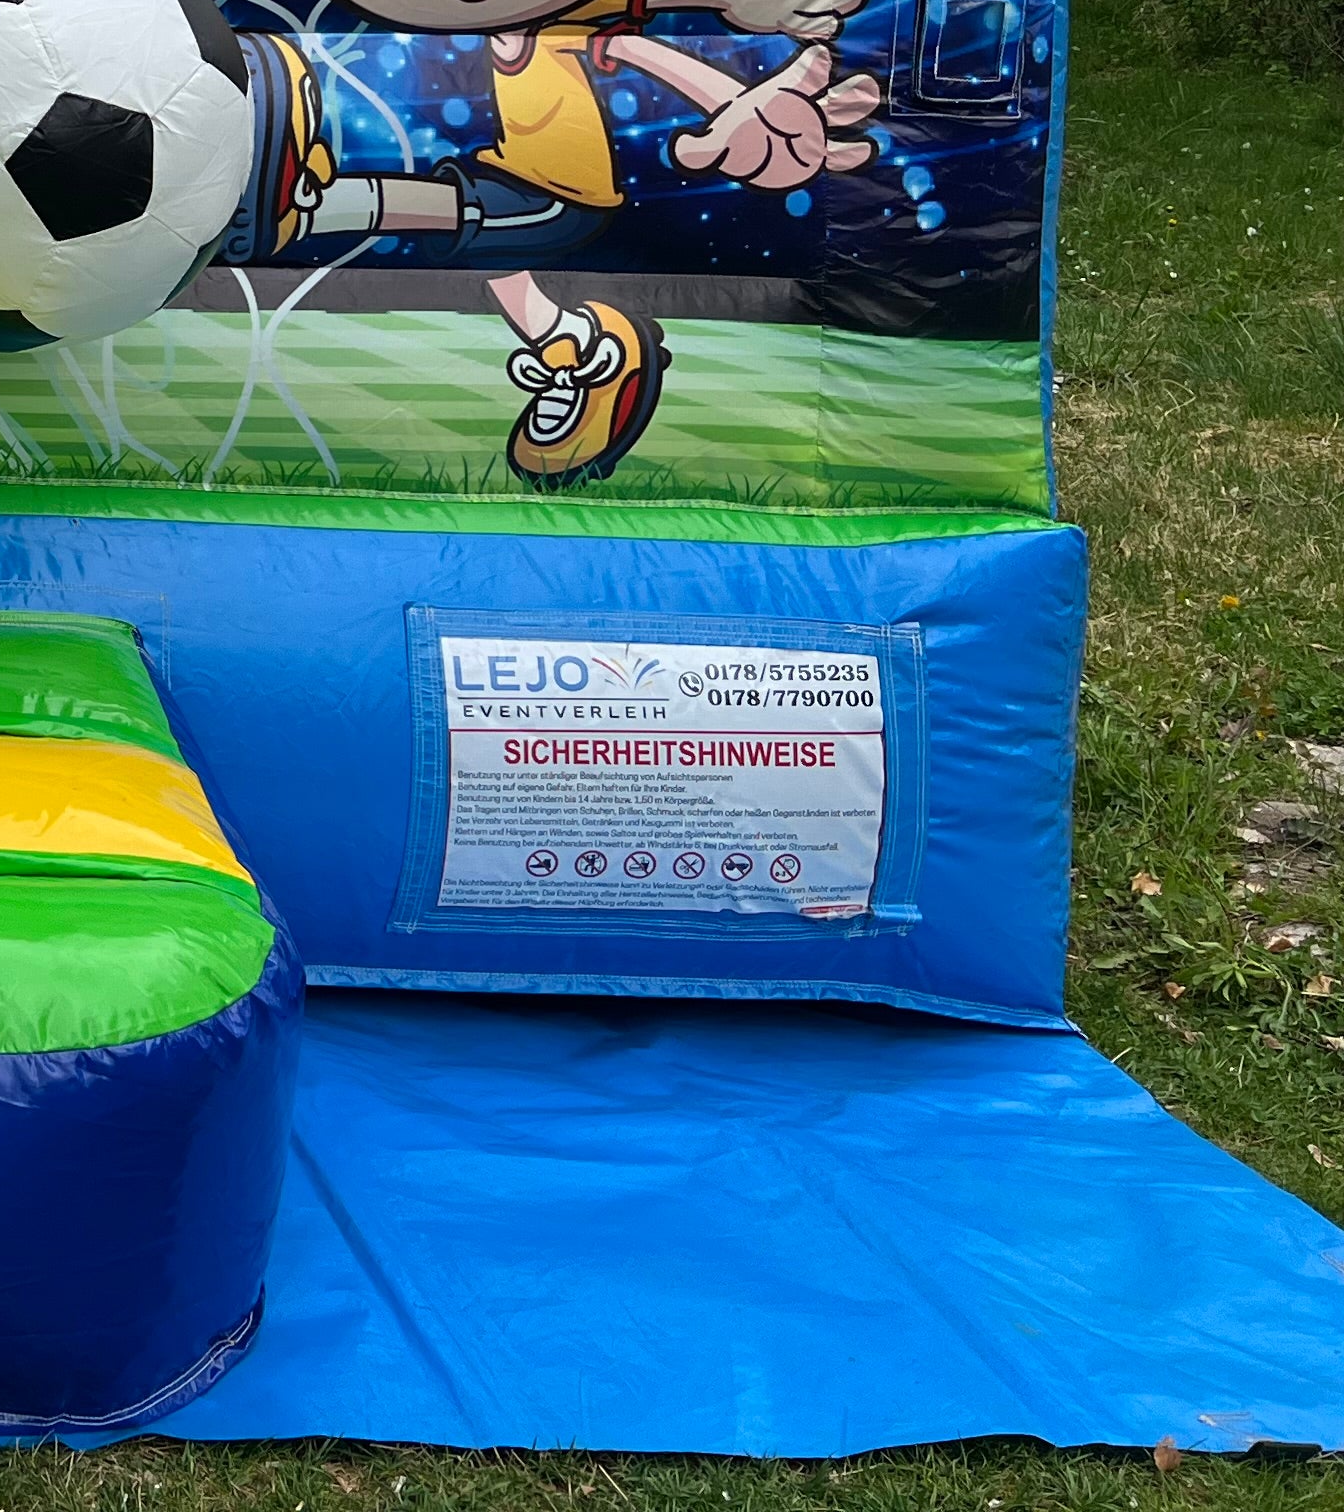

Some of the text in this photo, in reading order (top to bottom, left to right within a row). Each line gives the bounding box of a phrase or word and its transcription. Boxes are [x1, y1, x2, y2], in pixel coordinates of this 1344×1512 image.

[453, 656, 588, 692] LEJO
[705, 663, 869, 682] 0178/5755235
[708, 689, 874, 707] 0178/7790700
[464, 705, 666, 718] EVENTVERLEIH
[504, 740, 835, 766] SICHERHEITSHINWEISE
[458, 770, 501, 781] Benutzung
[657, 773, 733, 782] Aufsichtspersonen
[458, 782, 500, 792] Benutzung
[503, 783, 515, 791] auf
[518, 784, 544, 792] eigene
[458, 794, 500, 804] Benutzung
[533, 795, 562, 803] Kindern
[564, 795, 576, 803] bis
[591, 796, 613, 804] Jahre
[475, 806, 500, 815] Tragen
[519, 807, 562, 815] Mitbringen
[687, 808, 723, 816] scharfen
[831, 809, 840, 817] ist
[685, 819, 695, 827] ist
[638, 830, 653, 838] und
[478, 839, 520, 848] Benutzung
[770, 843, 787, 851] oder
